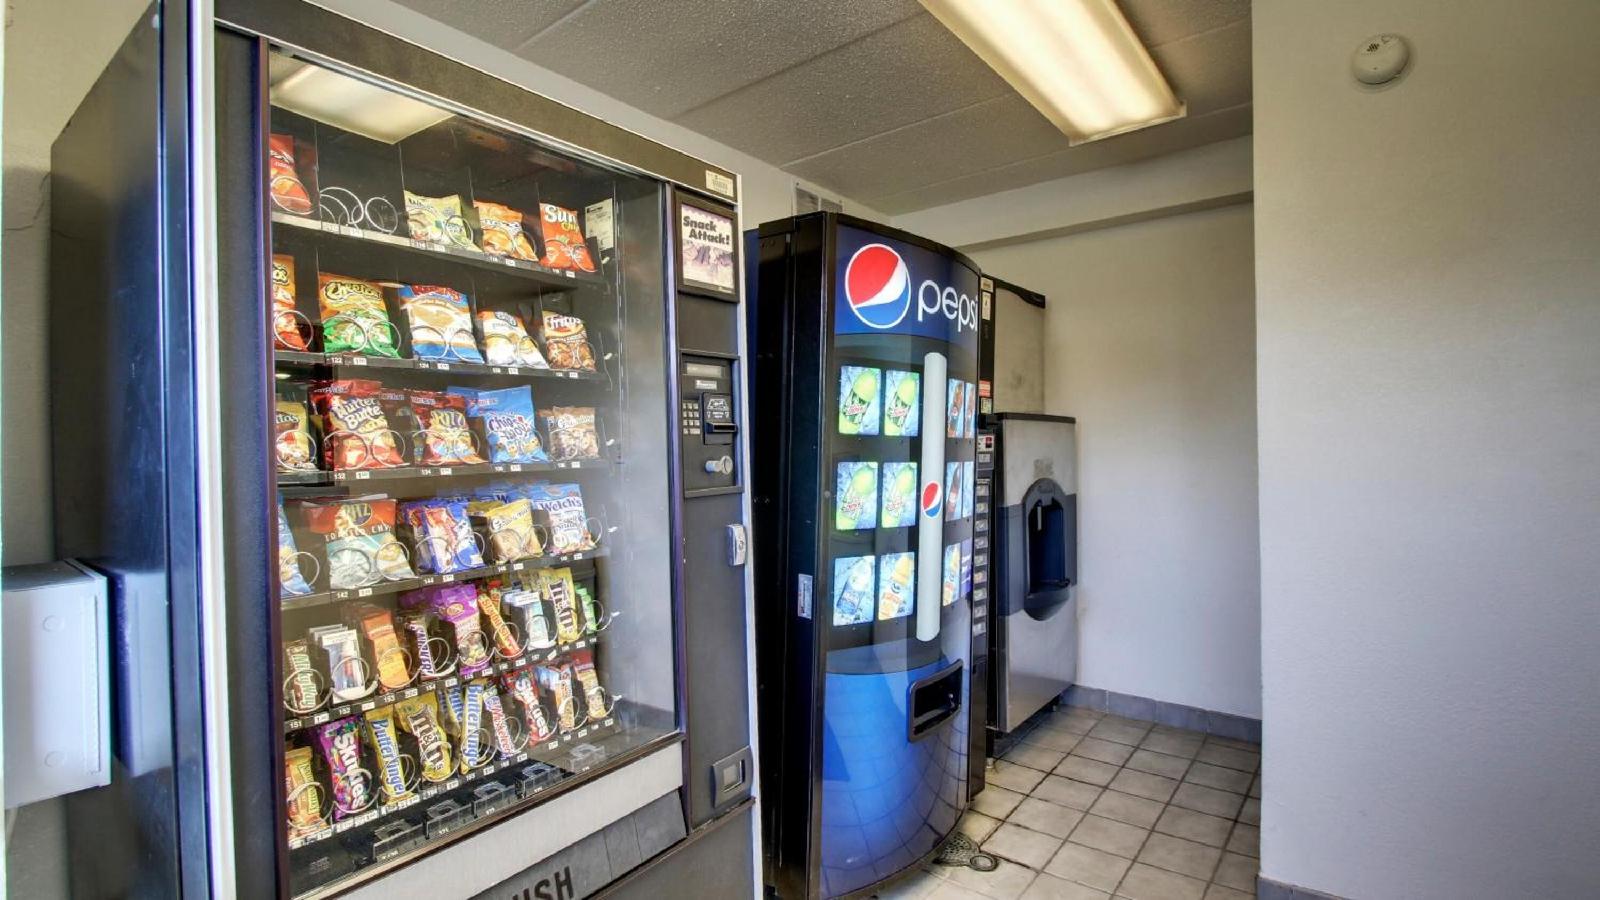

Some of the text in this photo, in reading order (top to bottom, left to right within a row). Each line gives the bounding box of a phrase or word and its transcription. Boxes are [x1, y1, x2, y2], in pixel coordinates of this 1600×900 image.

[544, 204, 578, 224] Sun
[683, 216, 717, 232] Snack
[689, 228, 730, 245] Attack!
[917, 279, 978, 333] pepsi
[540, 496, 583, 513] Welch's
[290, 721, 302, 729] 151
[466, 685, 484, 767] Butterfinge
